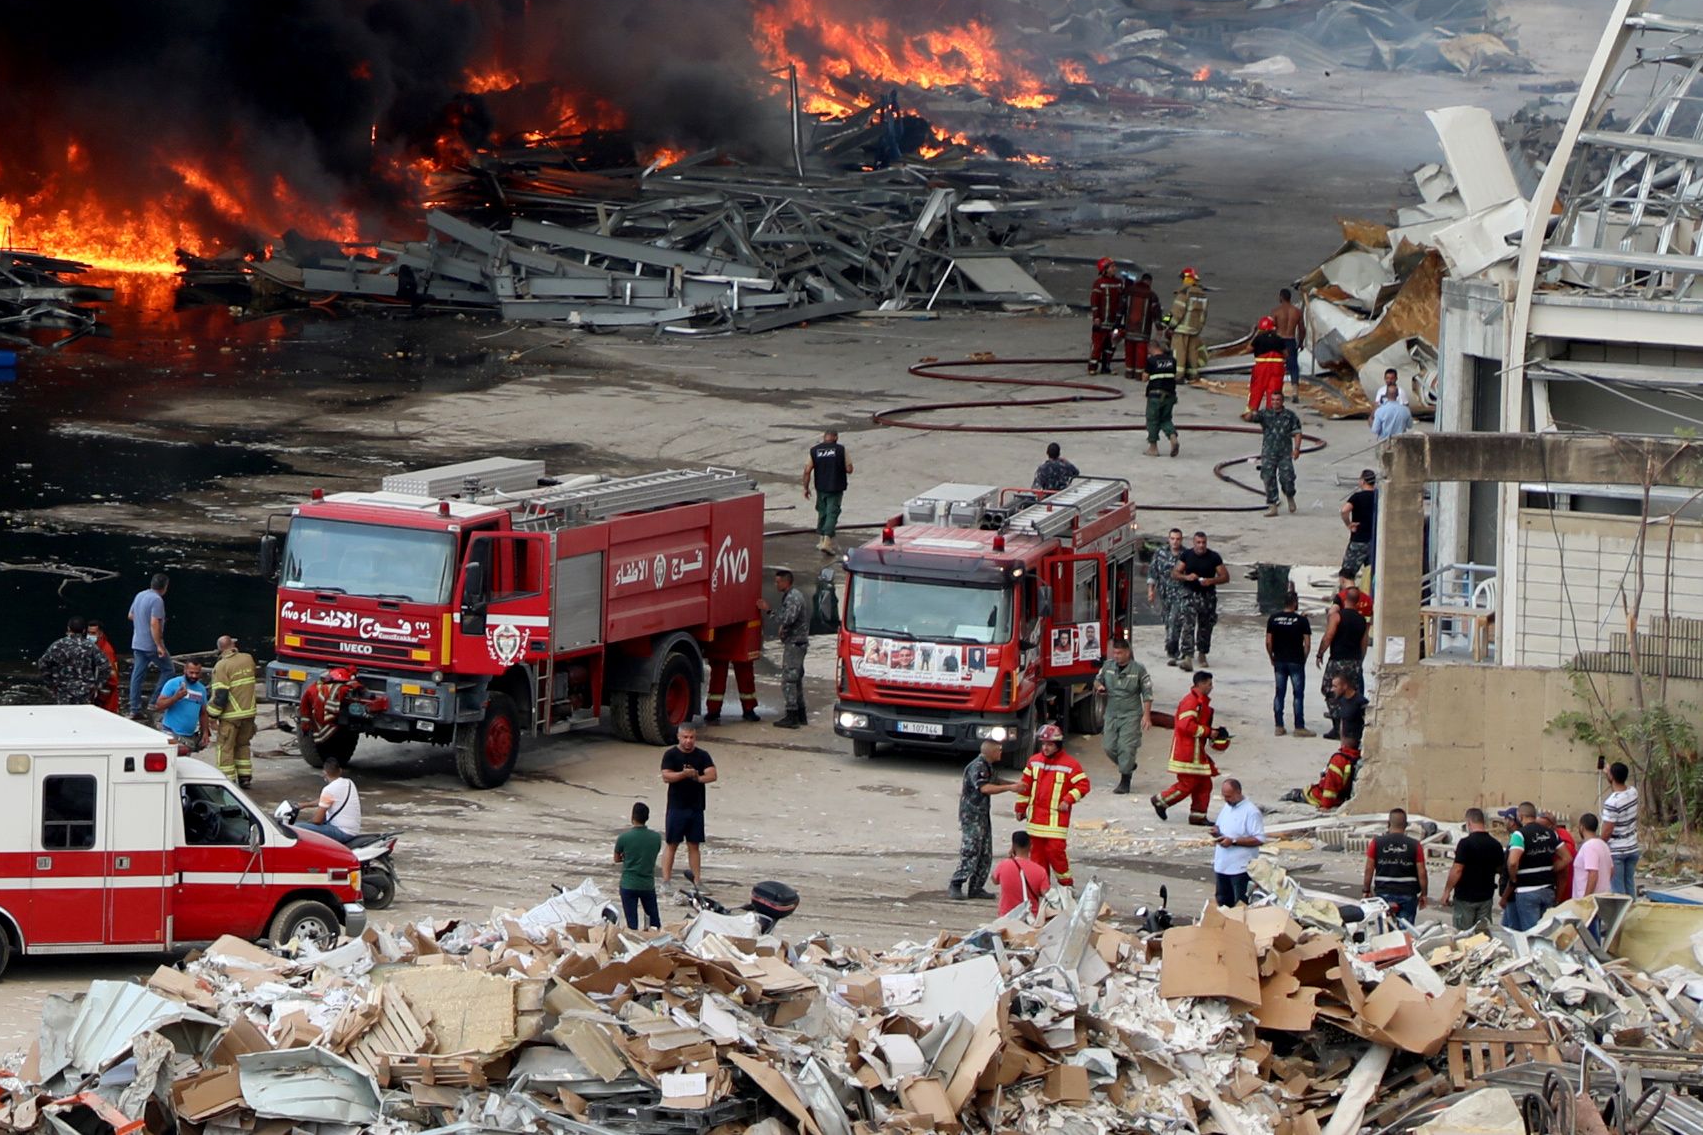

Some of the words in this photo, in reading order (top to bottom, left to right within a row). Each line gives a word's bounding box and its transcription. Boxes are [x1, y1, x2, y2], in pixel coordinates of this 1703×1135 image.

[614, 559, 649, 587] الاطفاء
[671, 549, 703, 581] فوج
[299, 608, 358, 629] الاطفاء
[359, 617, 412, 639] فوج
[339, 642, 373, 655] IVECO
[1382, 843, 1408, 854] الجيش
